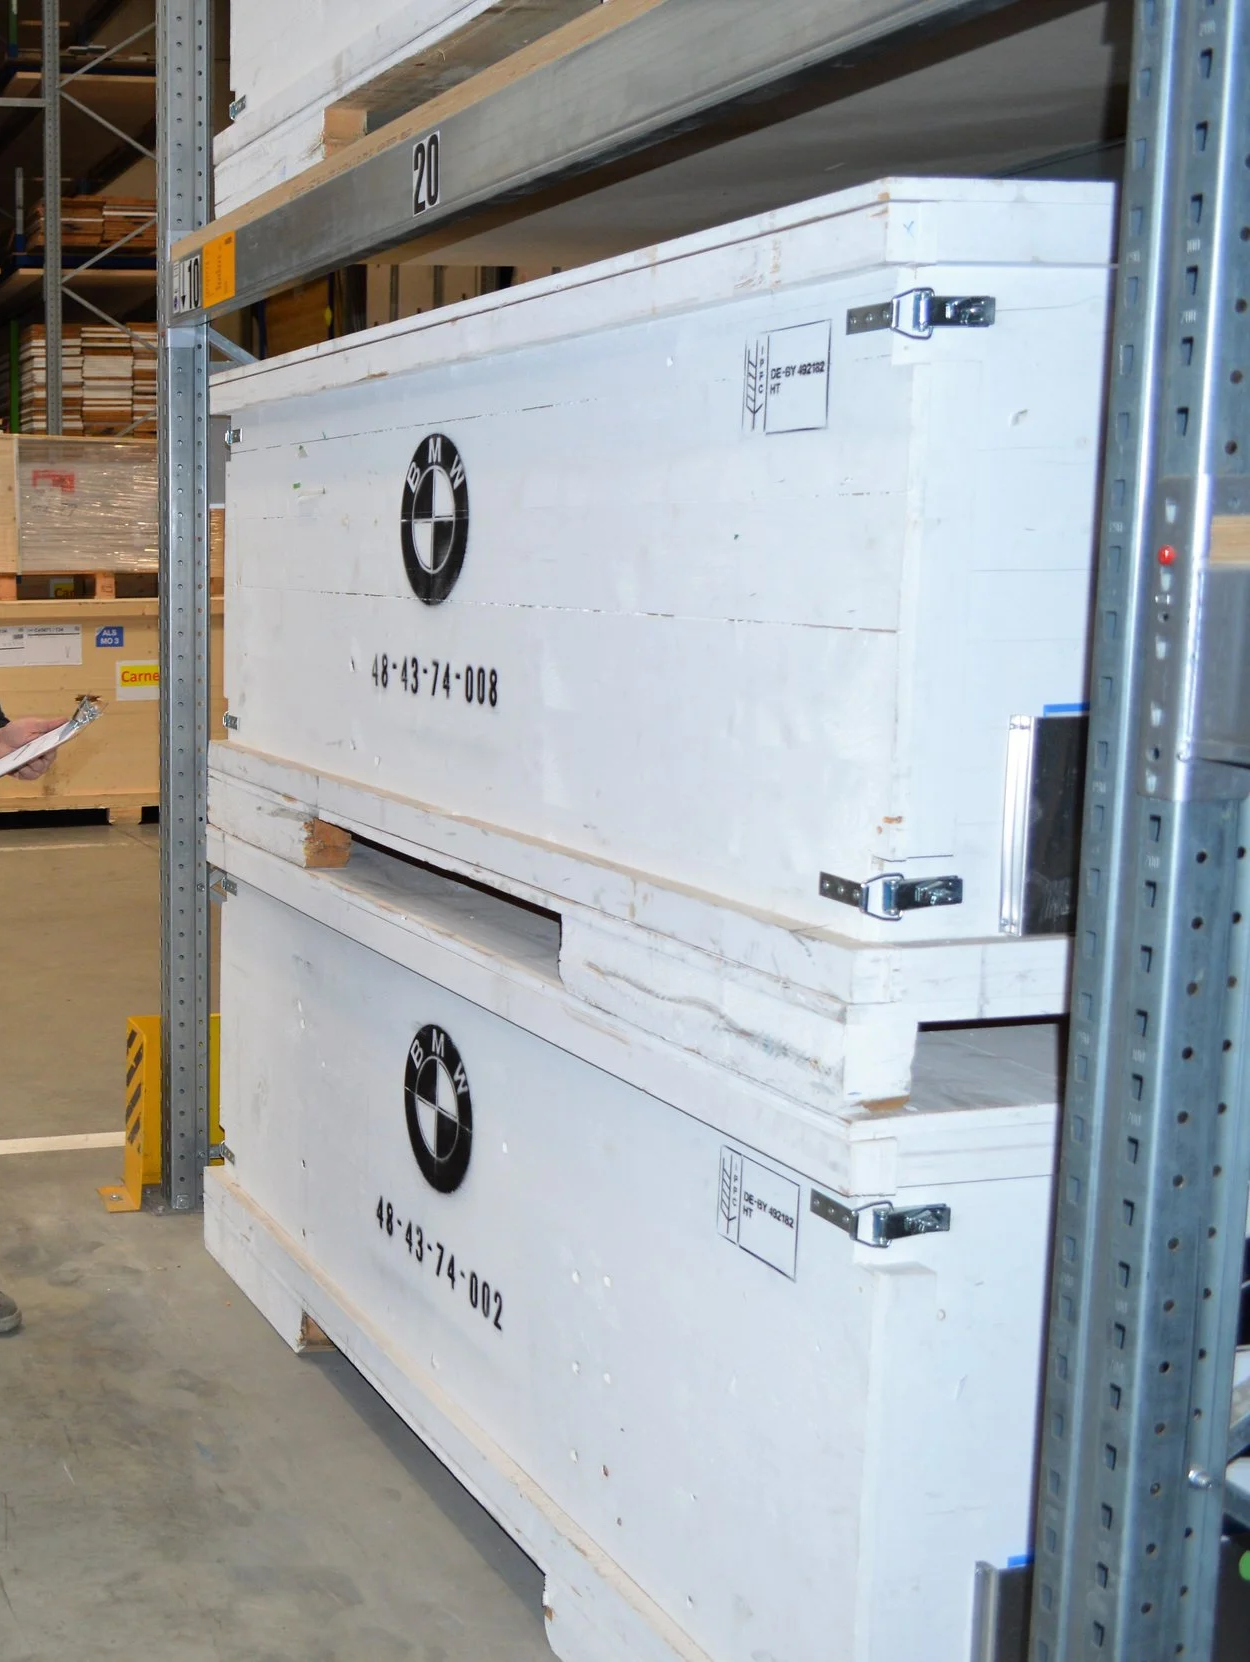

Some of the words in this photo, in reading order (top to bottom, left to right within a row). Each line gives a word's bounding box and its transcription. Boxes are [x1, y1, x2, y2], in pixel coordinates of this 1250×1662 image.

[413, 133, 439, 215] 20
[188, 258, 199, 309] 10
[770, 383, 781, 395] HT
[371, 653, 498, 707] 48-43-74-008
[743, 1191, 767, 1213] DE-BY
[743, 1205, 753, 1219] HT
[376, 1195, 502, 1331] 48-43-74-002
